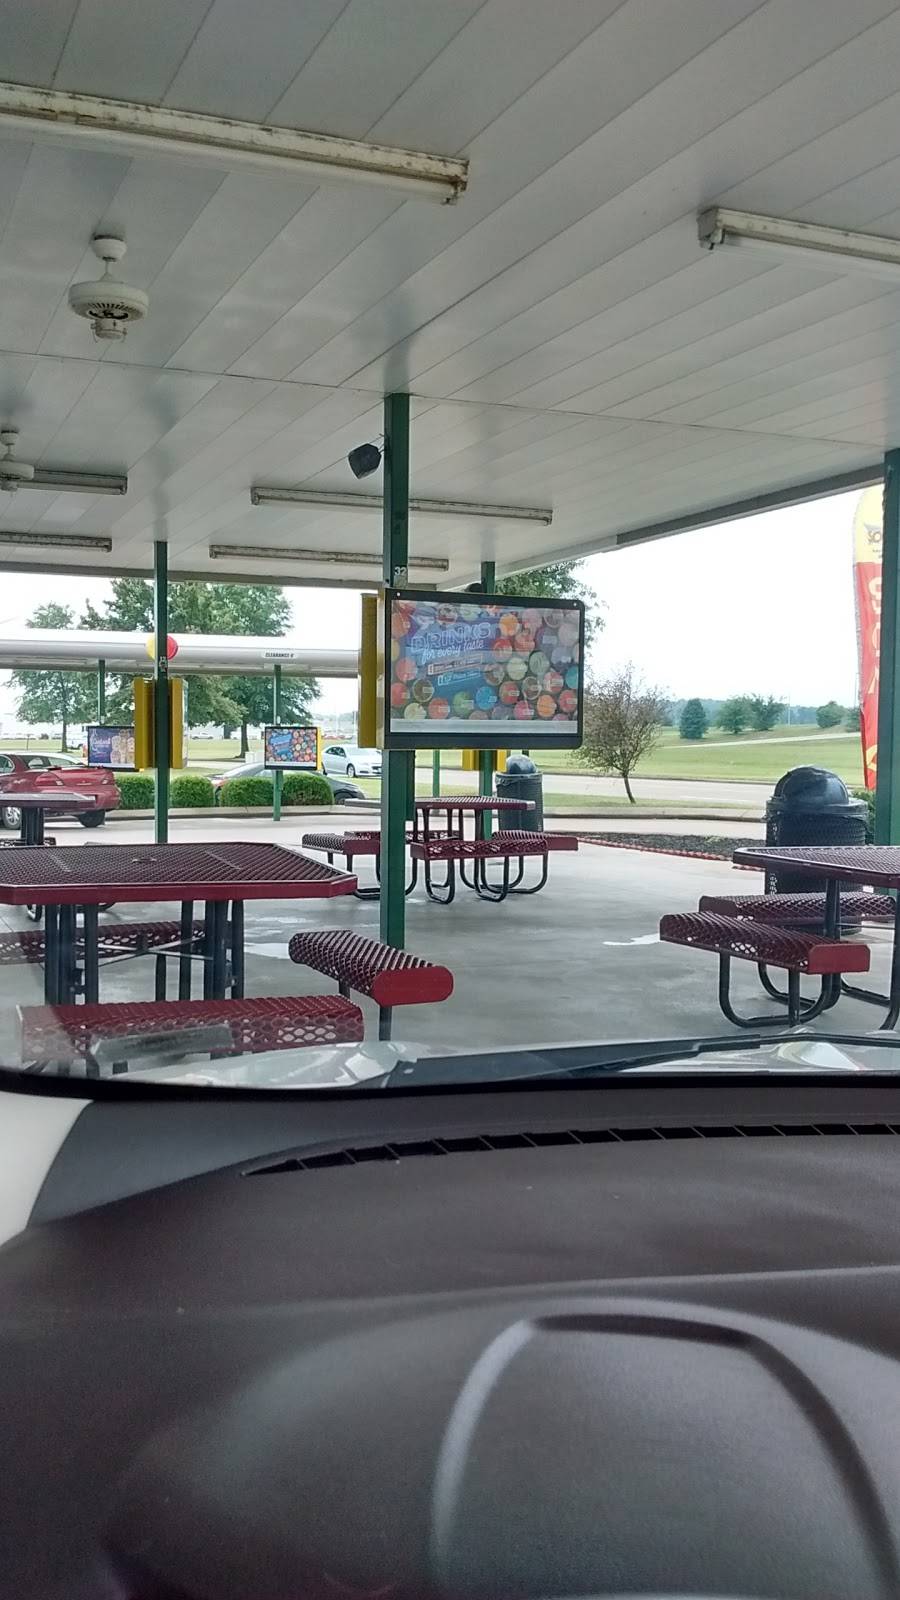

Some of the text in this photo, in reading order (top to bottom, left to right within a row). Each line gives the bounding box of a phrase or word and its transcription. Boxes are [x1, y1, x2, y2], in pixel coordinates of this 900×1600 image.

[395, 566, 407, 576] 32
[411, 622, 491, 653] DRINKS
[421, 640, 484, 664] for every taste
